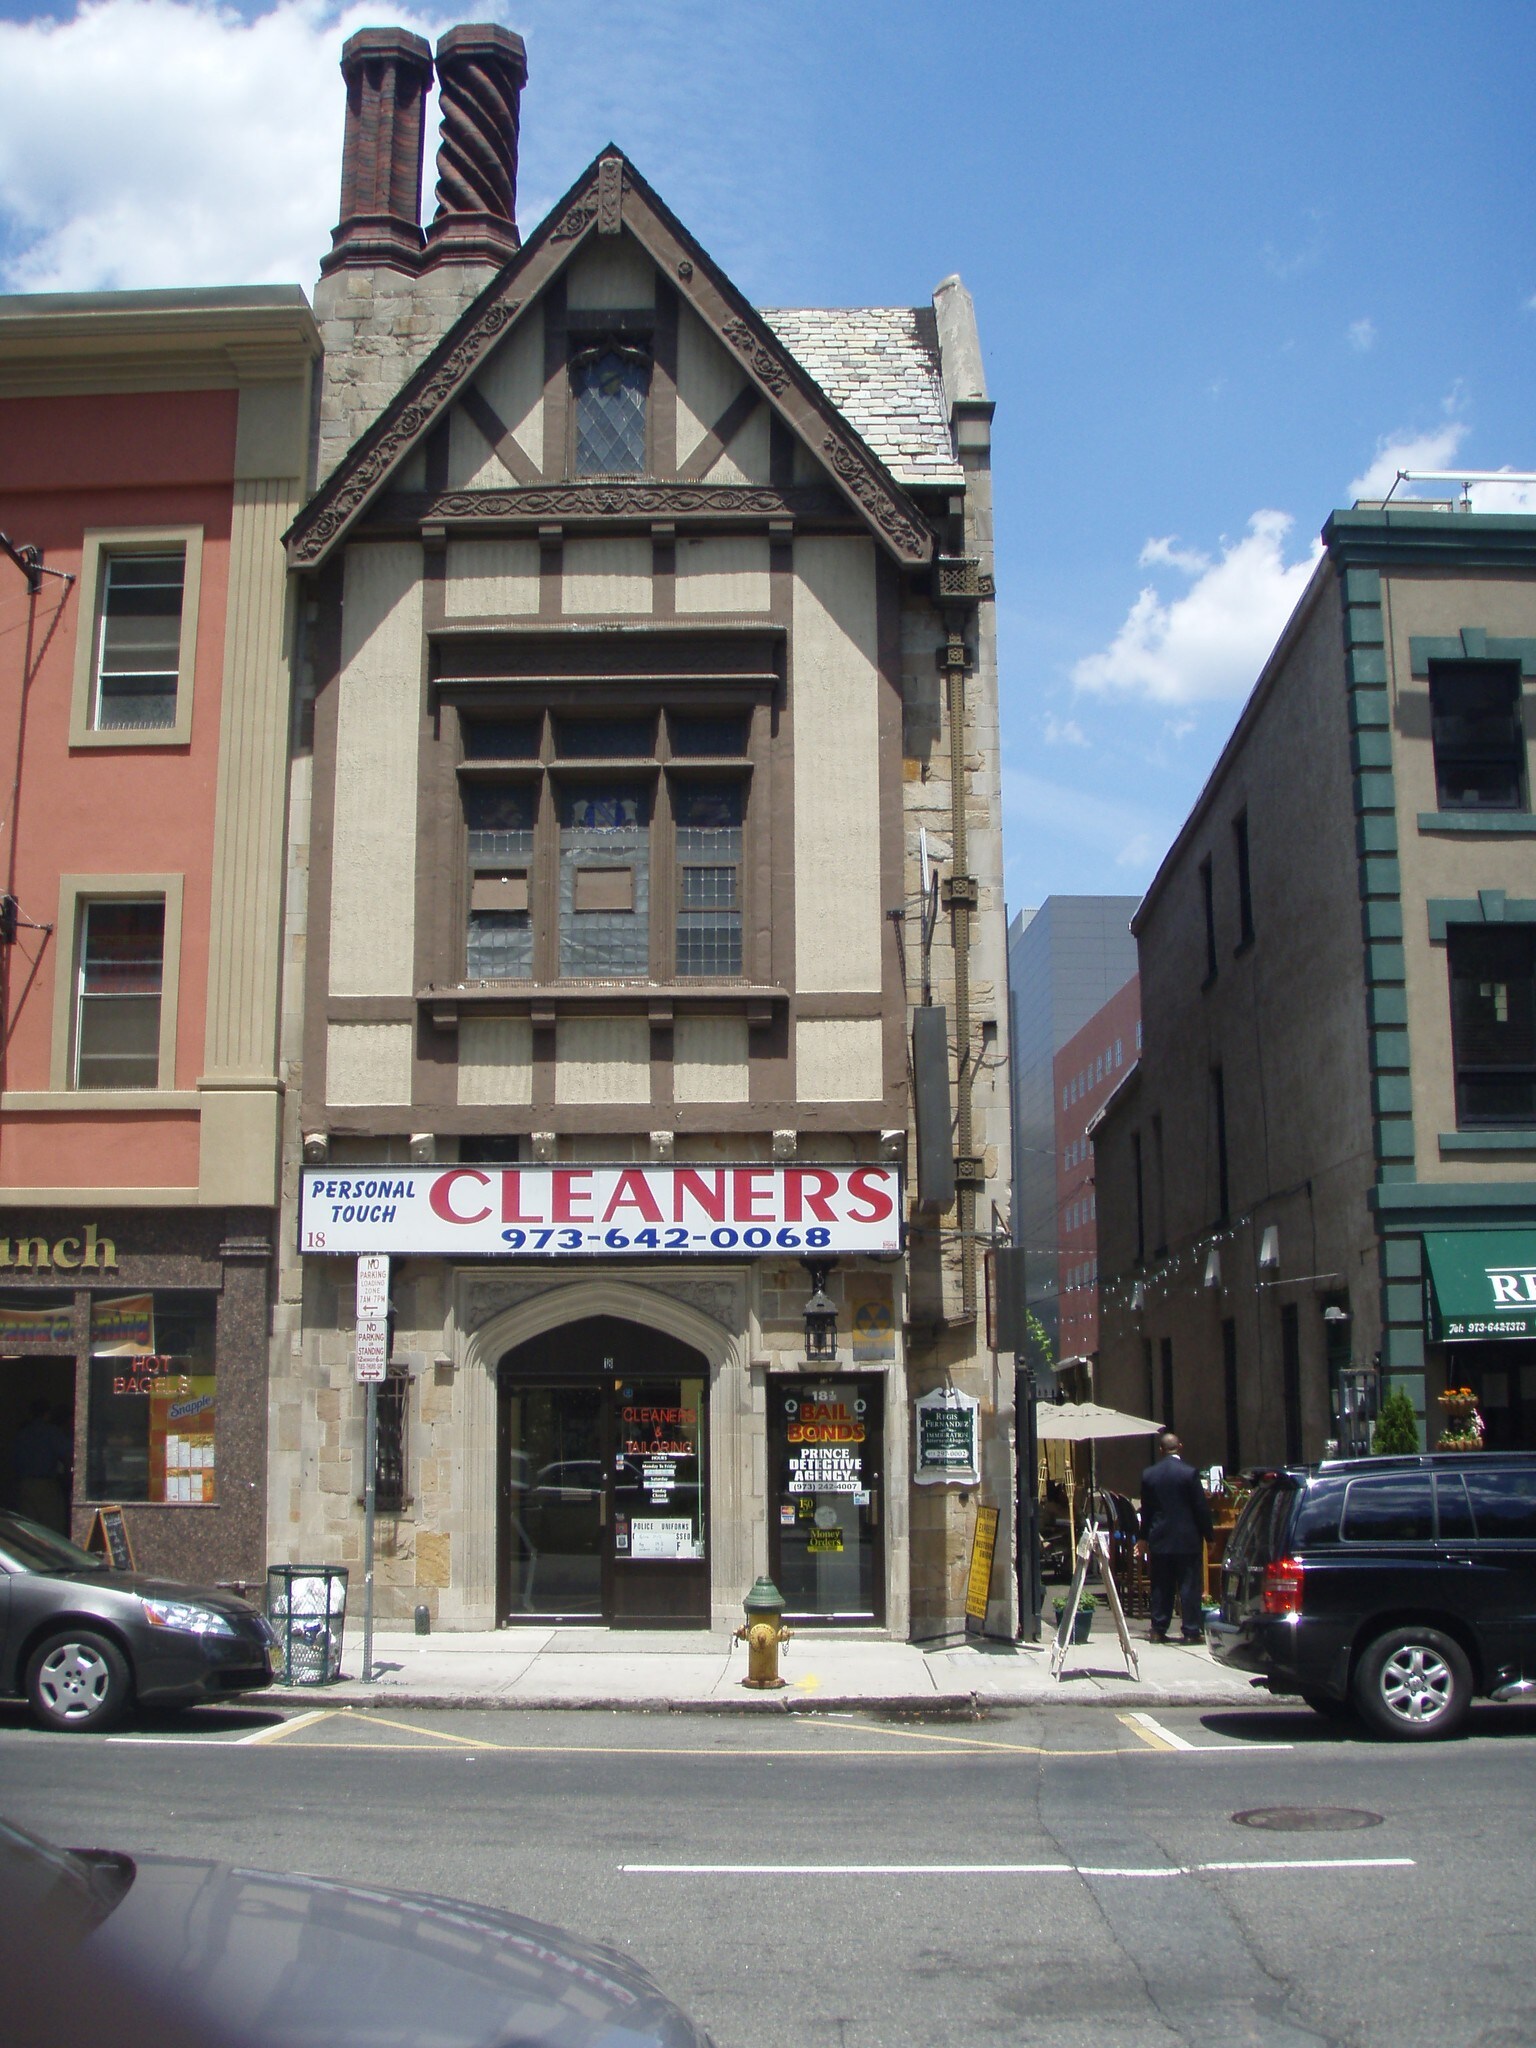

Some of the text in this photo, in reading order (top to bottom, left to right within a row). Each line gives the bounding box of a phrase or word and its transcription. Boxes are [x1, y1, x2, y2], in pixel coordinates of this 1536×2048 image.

[312, 1180, 415, 1199] PERSONAL
[428, 1167, 894, 1225] CLEANERS
[332, 1205, 397, 1223] TOUCH
[307, 1232, 326, 1248] 18
[501, 1227, 832, 1250] 973-642-0068
[367, 1259, 379, 1269] NO
[360, 1271, 386, 1279] PARKING
[366, 1324, 377, 1332] NO
[1449, 1323, 1464, 1334] Tel:
[358, 1333, 385, 1341] PARKING
[358, 1348, 384, 1356] STANDING
[132, 1356, 172, 1373] HOT
[113, 1374, 191, 1394] BAGELS
[170, 1396, 212, 1417] Snapple
[800, 1403, 853, 1421] BAIL
[623, 1407, 697, 1422] CLEANERS
[936, 1412, 958, 1420] REGIS
[787, 1423, 866, 1442] BONDS
[625, 1441, 693, 1455] TAILORING
[801, 1448, 850, 1459] PRINCE
[789, 1458, 862, 1470] DETECTIVE
[794, 1470, 850, 1481] AGENCY
[794, 1482, 816, 1491] (973)
[811, 1529, 840, 1539] Money
